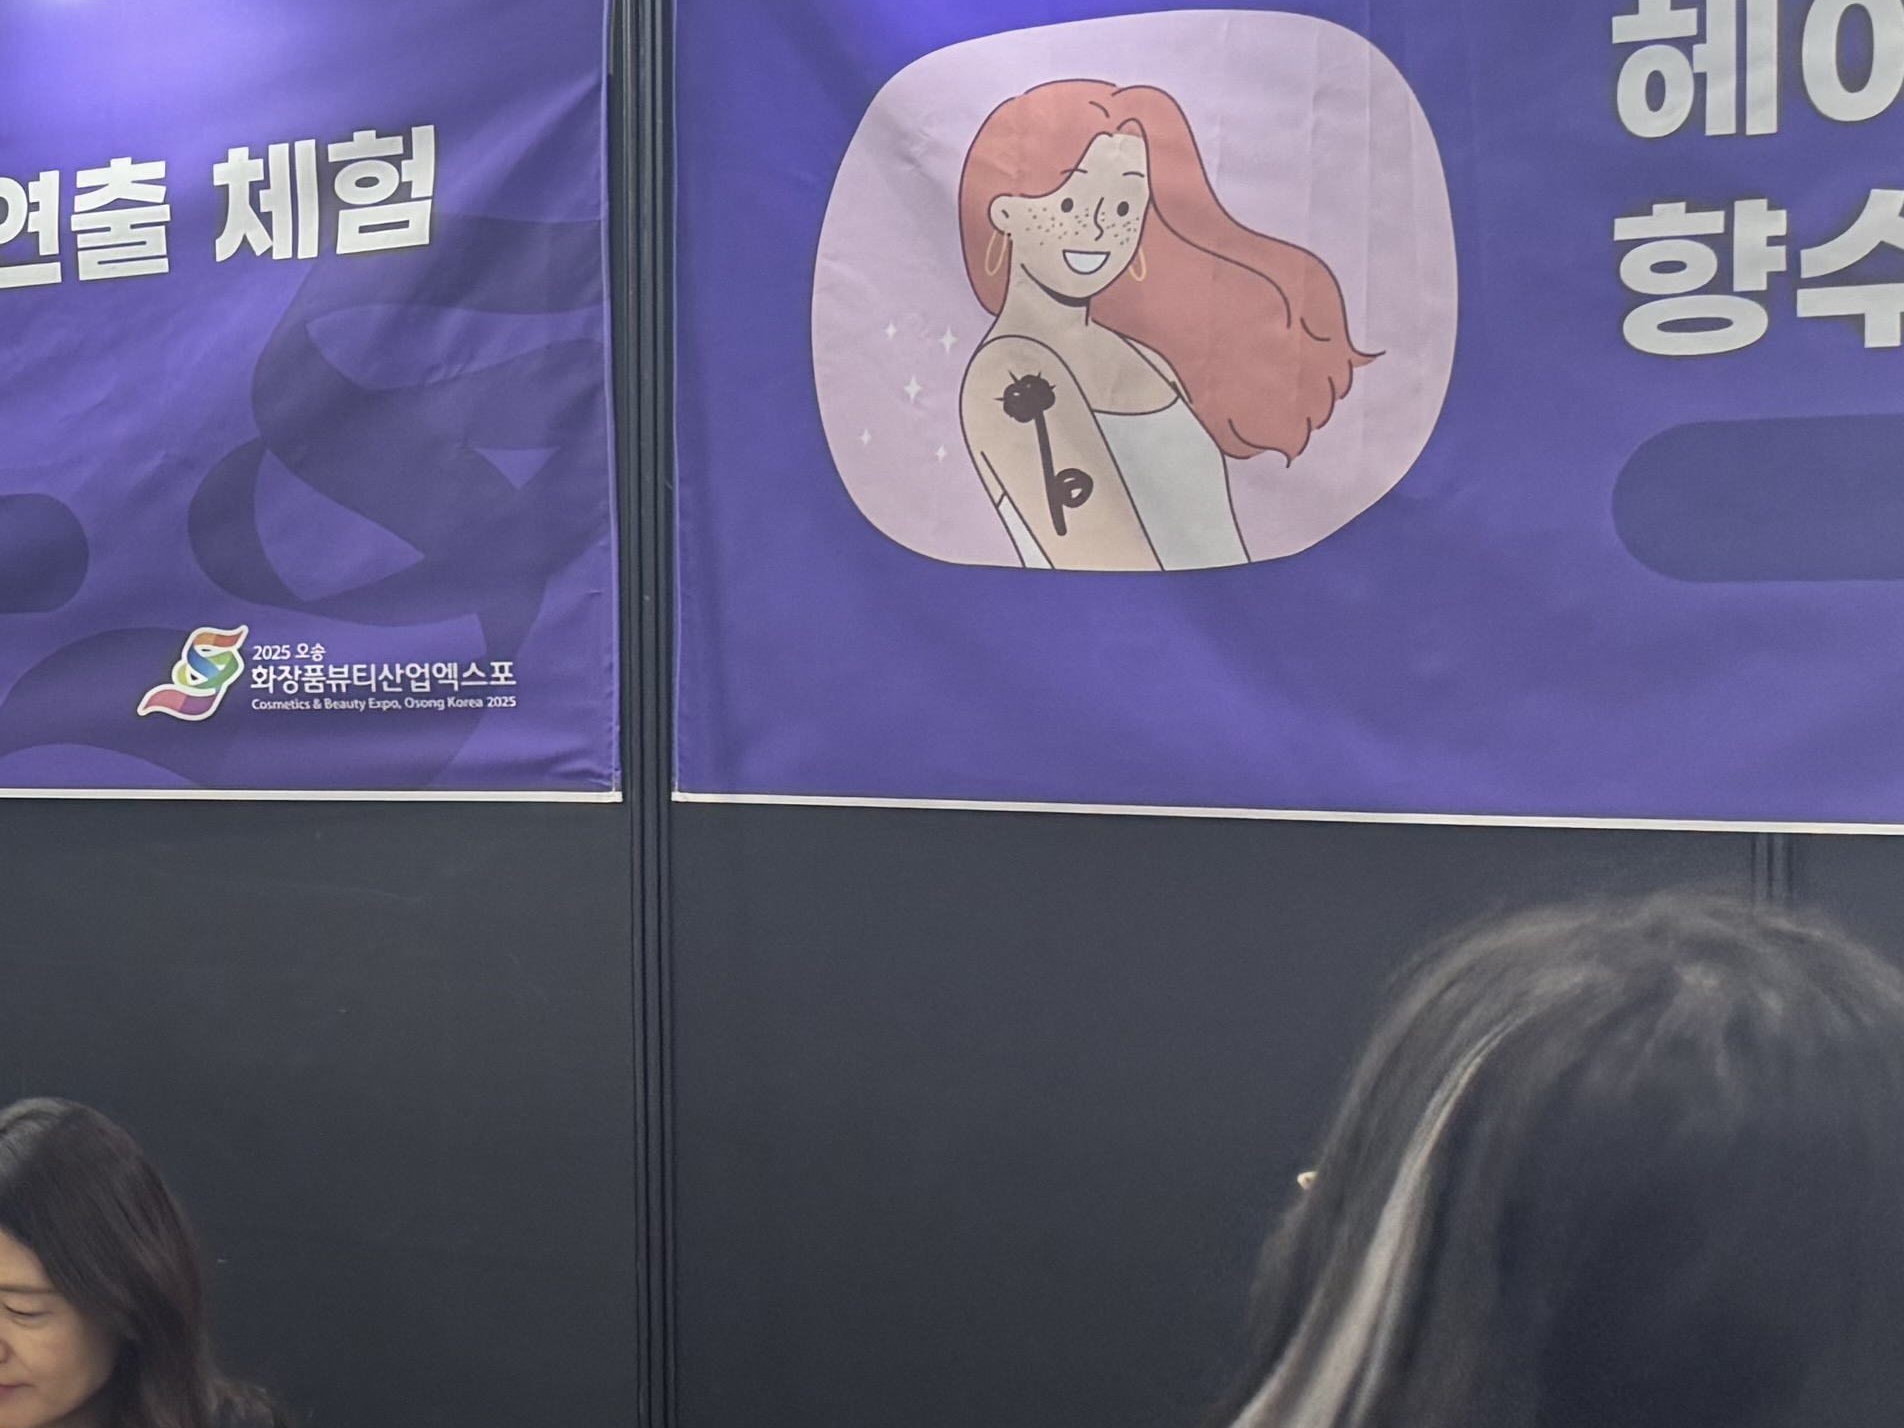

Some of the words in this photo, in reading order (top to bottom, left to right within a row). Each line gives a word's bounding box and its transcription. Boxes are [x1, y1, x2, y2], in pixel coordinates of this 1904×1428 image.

[213, 124, 435, 264] 체험
[252, 643, 291, 661] 2025
[294, 641, 327, 662] 오송
[250, 661, 517, 694] 화장품뷰티산업엑스포
[251, 698, 311, 711] Cosmetics
[314, 698, 323, 710] &
[325, 698, 365, 714] Beauty
[368, 697, 401, 714] Expo,
[404, 698, 444, 712] Osong
[447, 695, 482, 709] Korea
[485, 695, 517, 709] 2025
